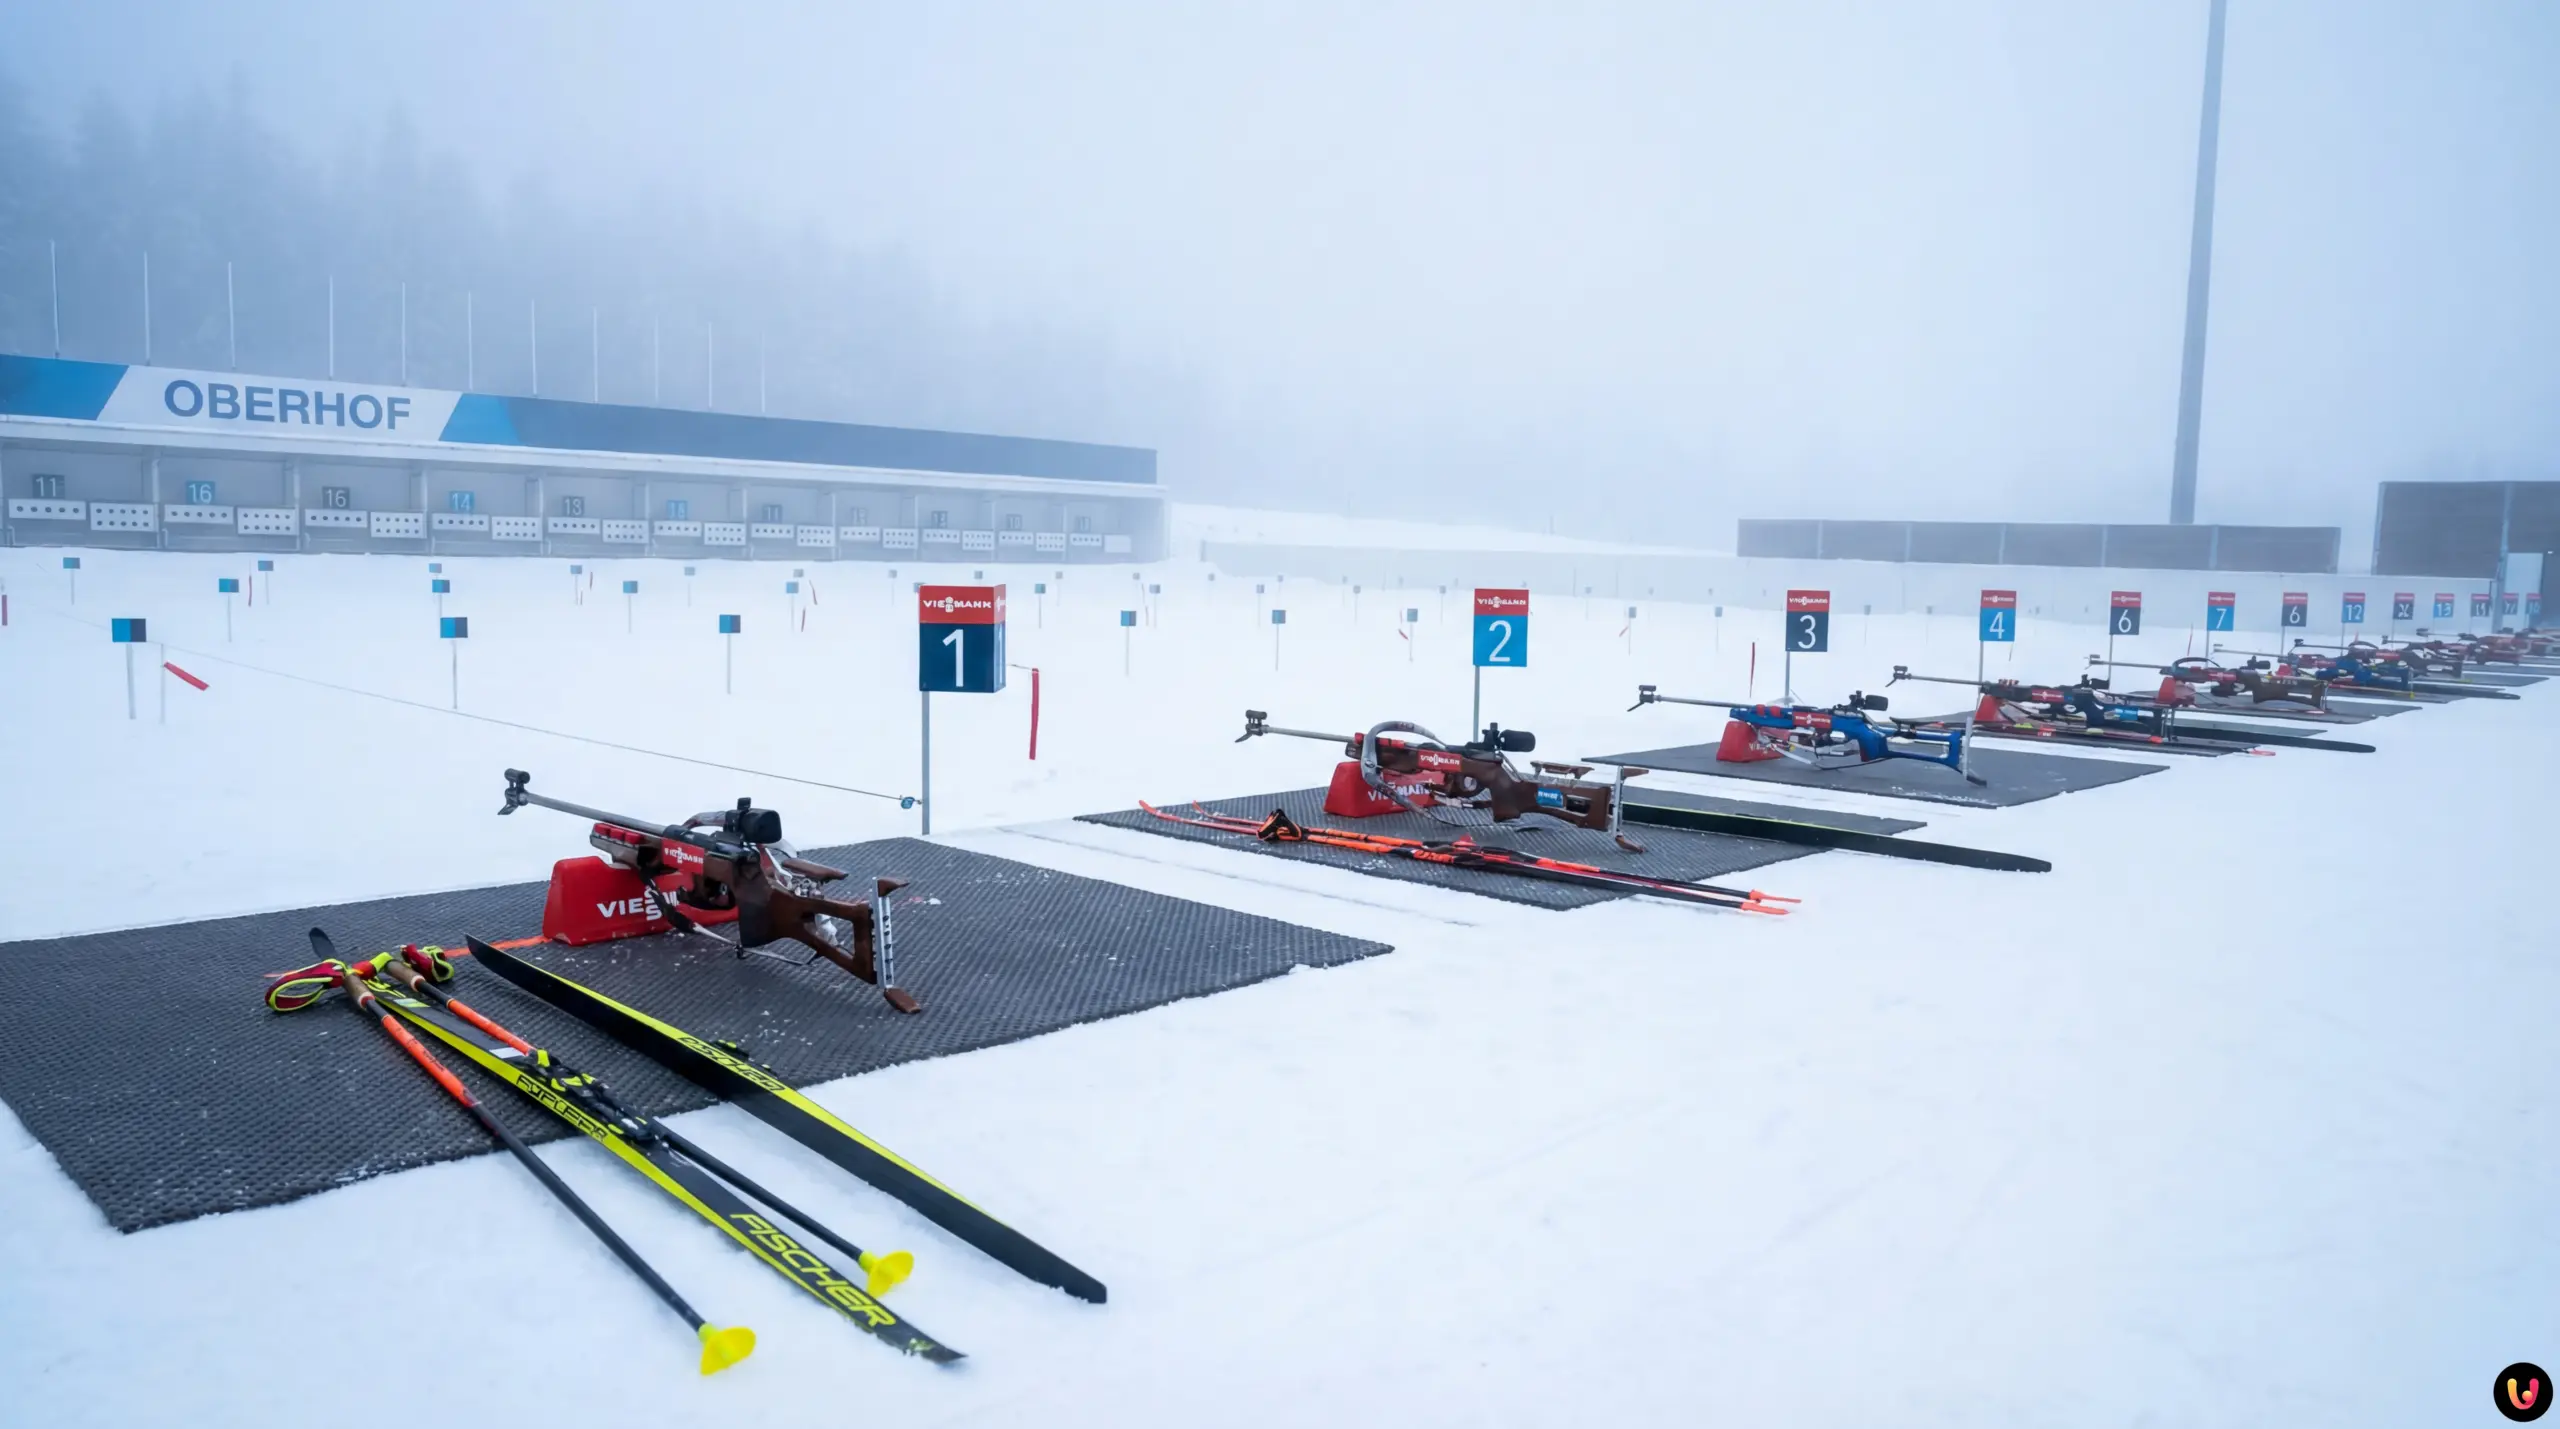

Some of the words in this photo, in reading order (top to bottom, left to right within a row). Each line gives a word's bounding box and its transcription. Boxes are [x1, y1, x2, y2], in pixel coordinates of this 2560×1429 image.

[165, 380, 411, 429] OBERHOF
[36, 477, 56, 497] 11
[188, 483, 212, 504] 16
[326, 489, 347, 507] 16
[2118, 609, 2132, 633] 6
[2216, 608, 2227, 629] 7
[2289, 605, 2301, 624] 6
[2346, 604, 2362, 621] 12
[1798, 614, 1816, 649] 3
[1989, 611, 2005, 639] 4
[1489, 620, 1512, 662] 2
[942, 629, 964, 687] 1
[729, 1214, 896, 1327] FISCHER
